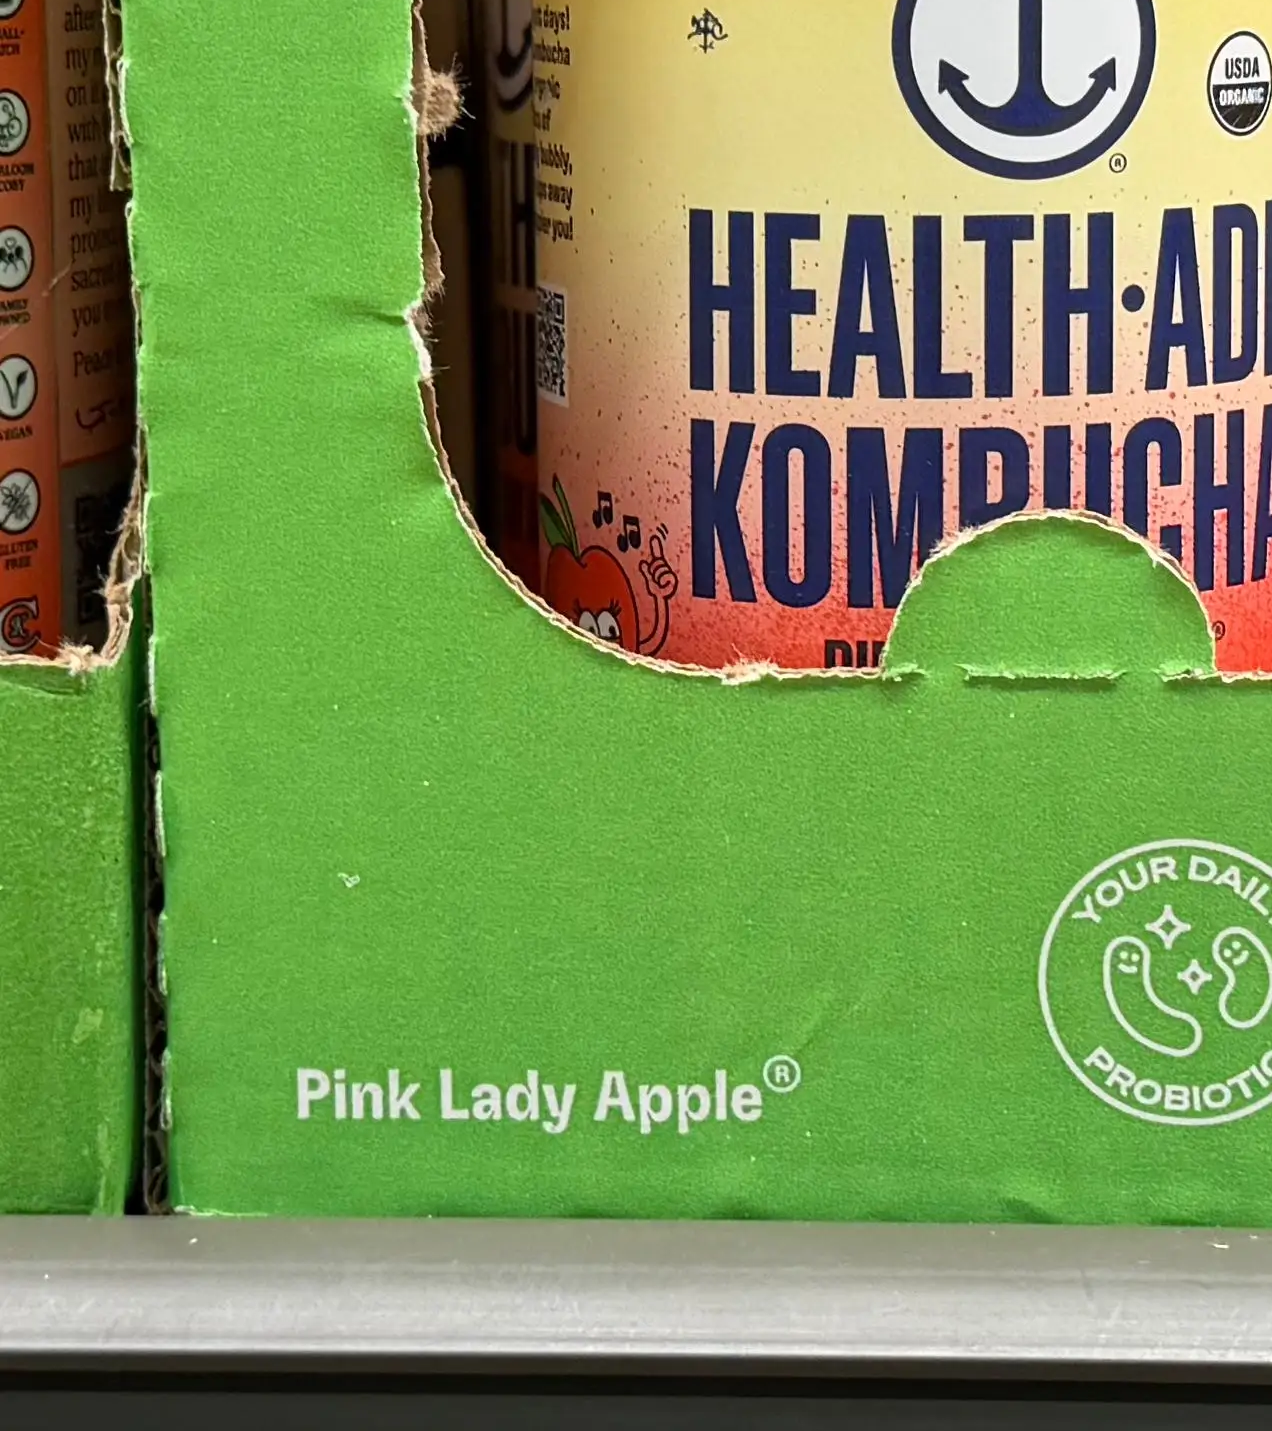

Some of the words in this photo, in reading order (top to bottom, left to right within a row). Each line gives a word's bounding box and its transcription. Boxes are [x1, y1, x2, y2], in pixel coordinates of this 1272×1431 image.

[1224, 56, 1260, 79] USDA
[1218, 87, 1265, 107] ORGANIC
[1071, 856, 1179, 923] YOUR
[296, 1067, 422, 1121] Pink
[438, 1067, 577, 1134] Lady
